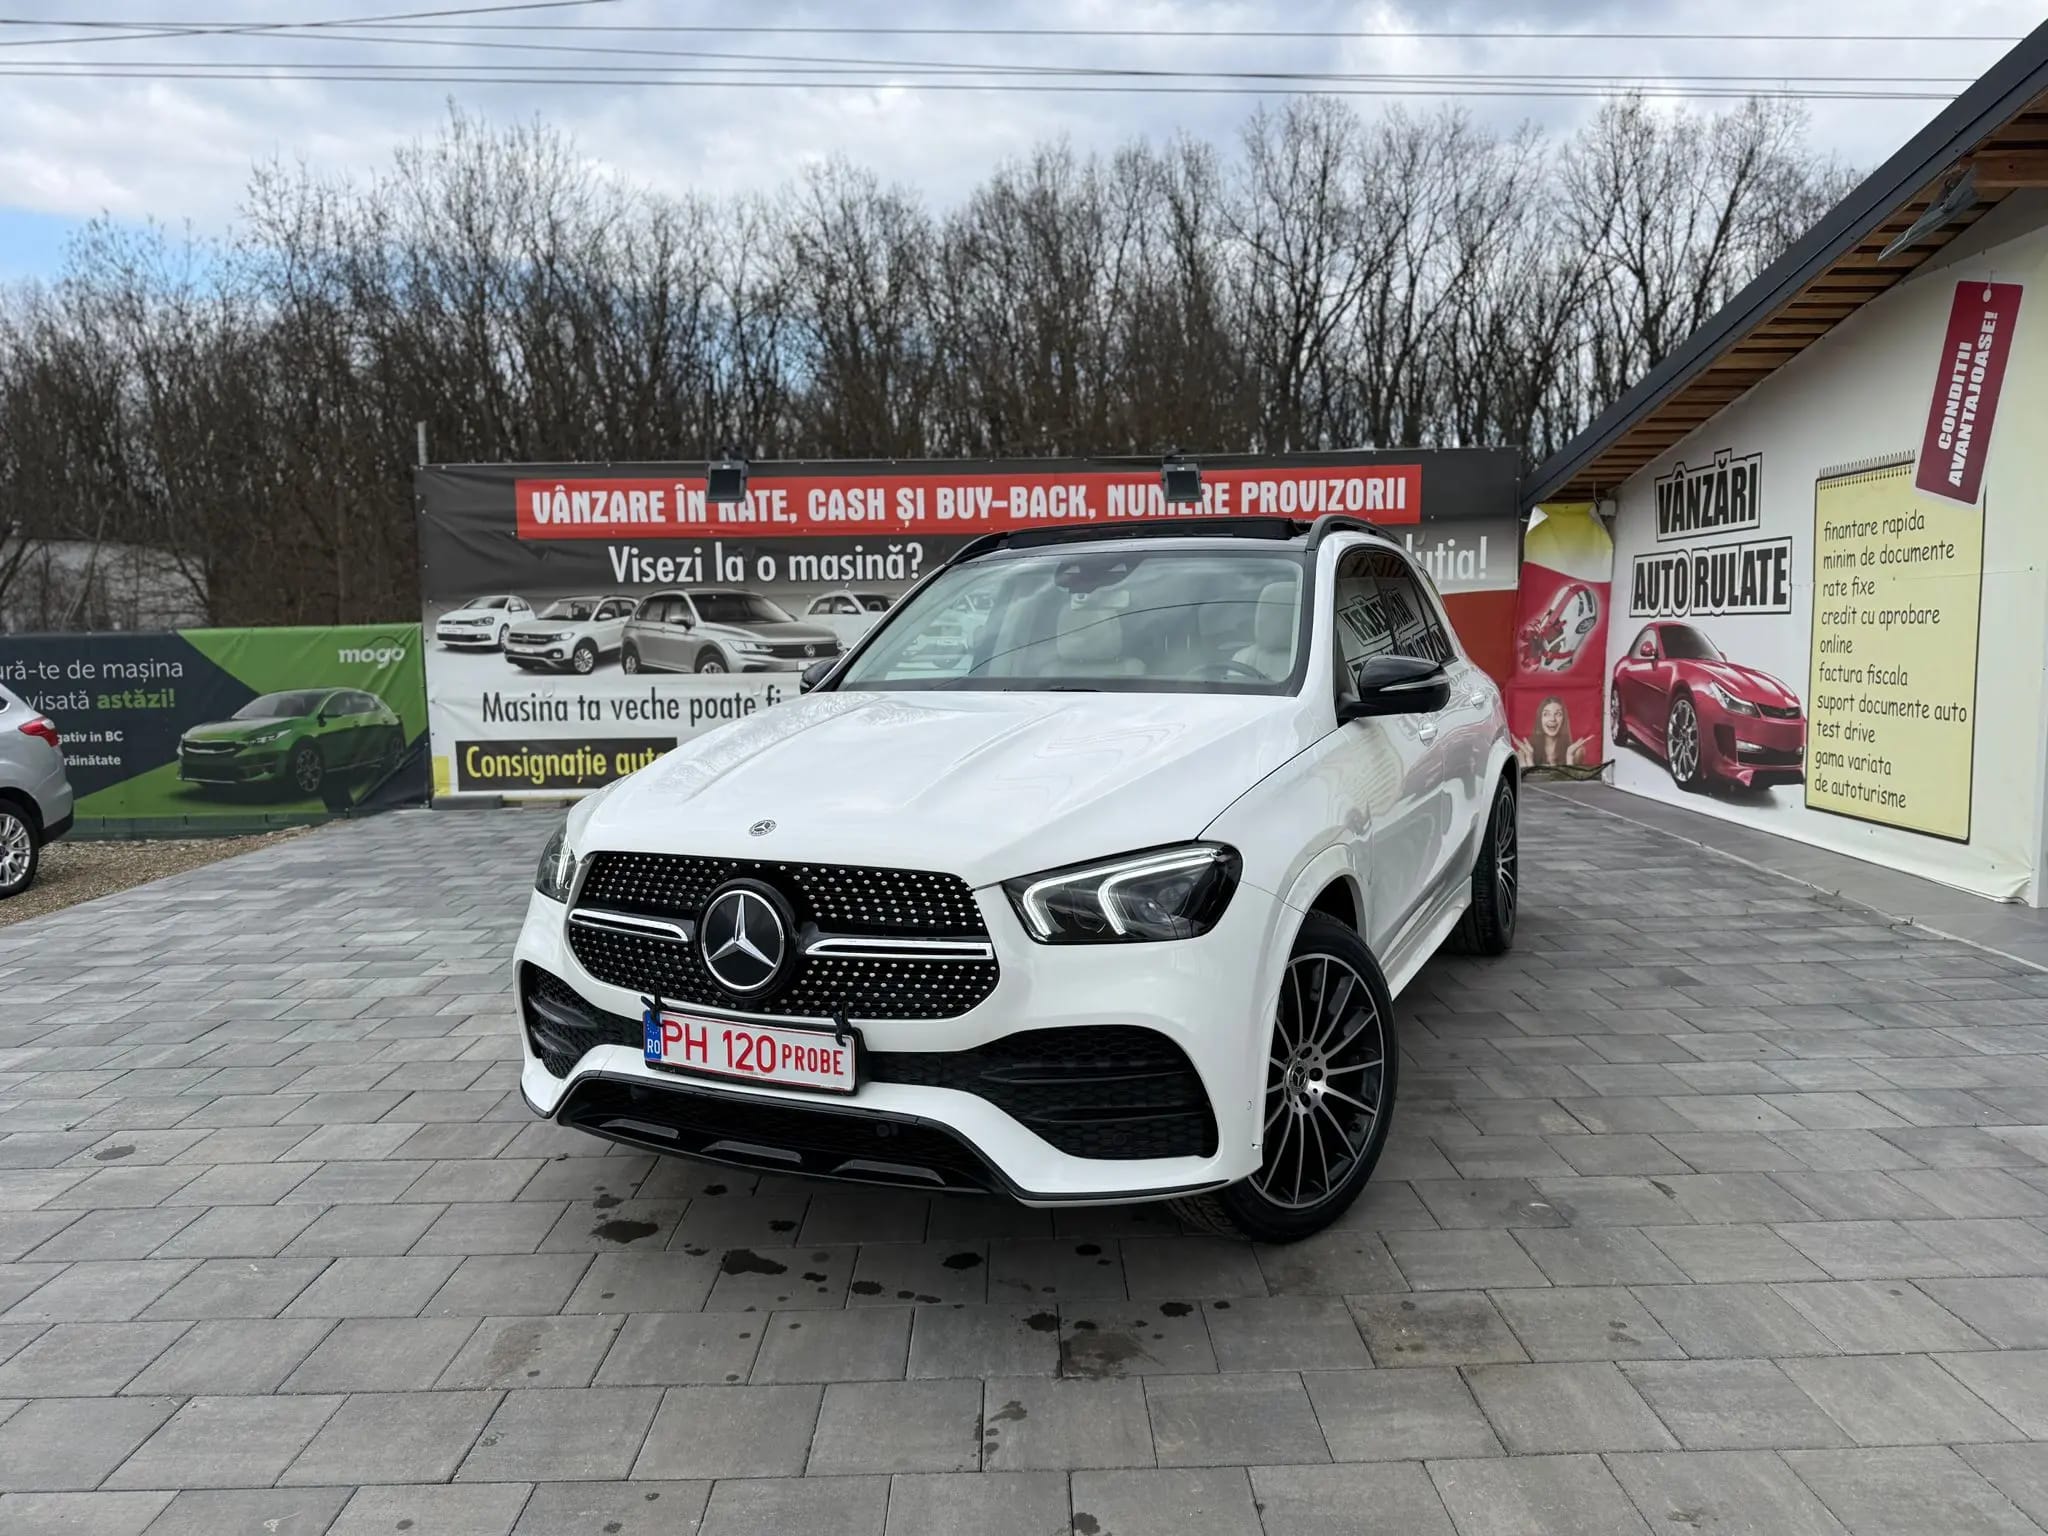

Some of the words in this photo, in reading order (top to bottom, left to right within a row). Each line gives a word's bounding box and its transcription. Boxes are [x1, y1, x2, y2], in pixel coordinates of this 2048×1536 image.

[1938, 341, 1973, 450] CONDITII
[1948, 311, 1999, 487] AVANTAJOASE!
[532, 485, 666, 524] VÂNZARE
[674, 484, 706, 523] ÎN
[808, 487, 886, 521] CASH
[896, 487, 925, 528] ȘI
[936, 485, 1096, 519] BUY-BACK,
[1241, 477, 1406, 514] PROVIZORII
[1658, 458, 1758, 534] VÂNZĂRI
[1824, 520, 1879, 542] finantare
[1882, 509, 1925, 538] rapida
[608, 546, 703, 584] Visezi
[714, 541, 744, 582] la
[757, 556, 777, 582] o
[1823, 549, 1856, 569] minim
[1860, 545, 1876, 566] de
[1879, 540, 1955, 564] documente
[1633, 557, 1689, 610] AUTO
[1694, 546, 1788, 608] RULATE
[1823, 580, 1848, 597] rate
[1851, 576, 1876, 597] fixe
[1821, 605, 1857, 625] credit
[1861, 609, 1875, 625] cu
[1879, 603, 1941, 631] aprobare
[338, 647, 405, 670] mogo
[1820, 634, 1853, 654] online
[67, 659, 96, 679] de
[103, 658, 183, 682] mașina
[1819, 661, 1863, 683] factura
[1867, 664, 1908, 686] fiscala
[26, 690, 90, 710] visată
[97, 688, 177, 709] astăzi!
[577, 695, 601, 721] ta
[610, 687, 680, 720] veche
[690, 693, 756, 727] poate
[1817, 693, 1855, 716] suport
[1858, 693, 1930, 719] documente
[1934, 702, 1967, 722] auto
[90, 731, 102, 742] in
[105, 731, 124, 742] BC
[1817, 720, 1841, 739] test
[1844, 721, 1876, 743] drive
[465, 745, 606, 784] Consignație
[615, 747, 665, 775] aut
[1815, 751, 1844, 769] gama
[1848, 754, 1892, 775] variata
[1815, 773, 1828, 792] de
[1831, 780, 1906, 808] autoturisme
[647, 1038, 661, 1055] RO
[661, 1019, 708, 1064] PH
[722, 1030, 777, 1073] 120
[781, 1043, 845, 1076] PROBE
